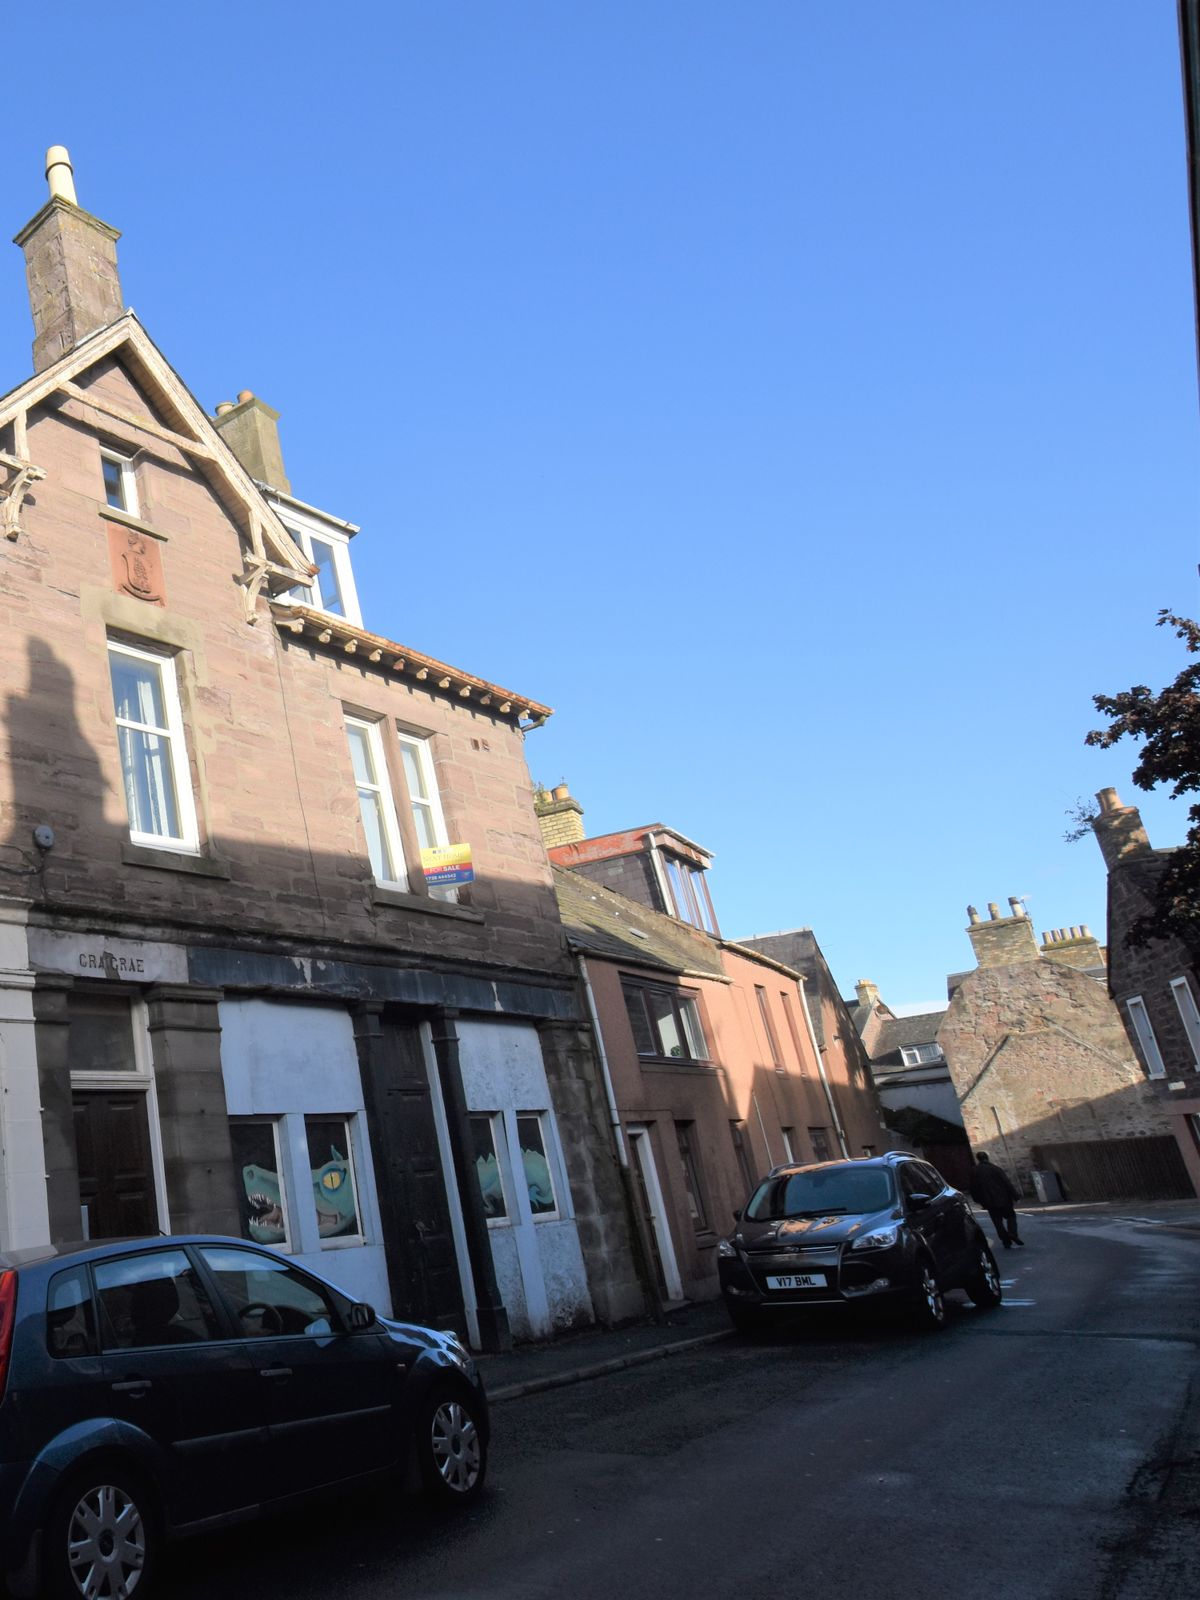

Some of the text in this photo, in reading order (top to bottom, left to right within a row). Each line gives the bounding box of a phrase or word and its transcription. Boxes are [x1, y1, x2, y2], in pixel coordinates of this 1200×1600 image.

[79, 953, 144, 973] CRAGRAE
[776, 1276, 816, 1287] V17 BML
